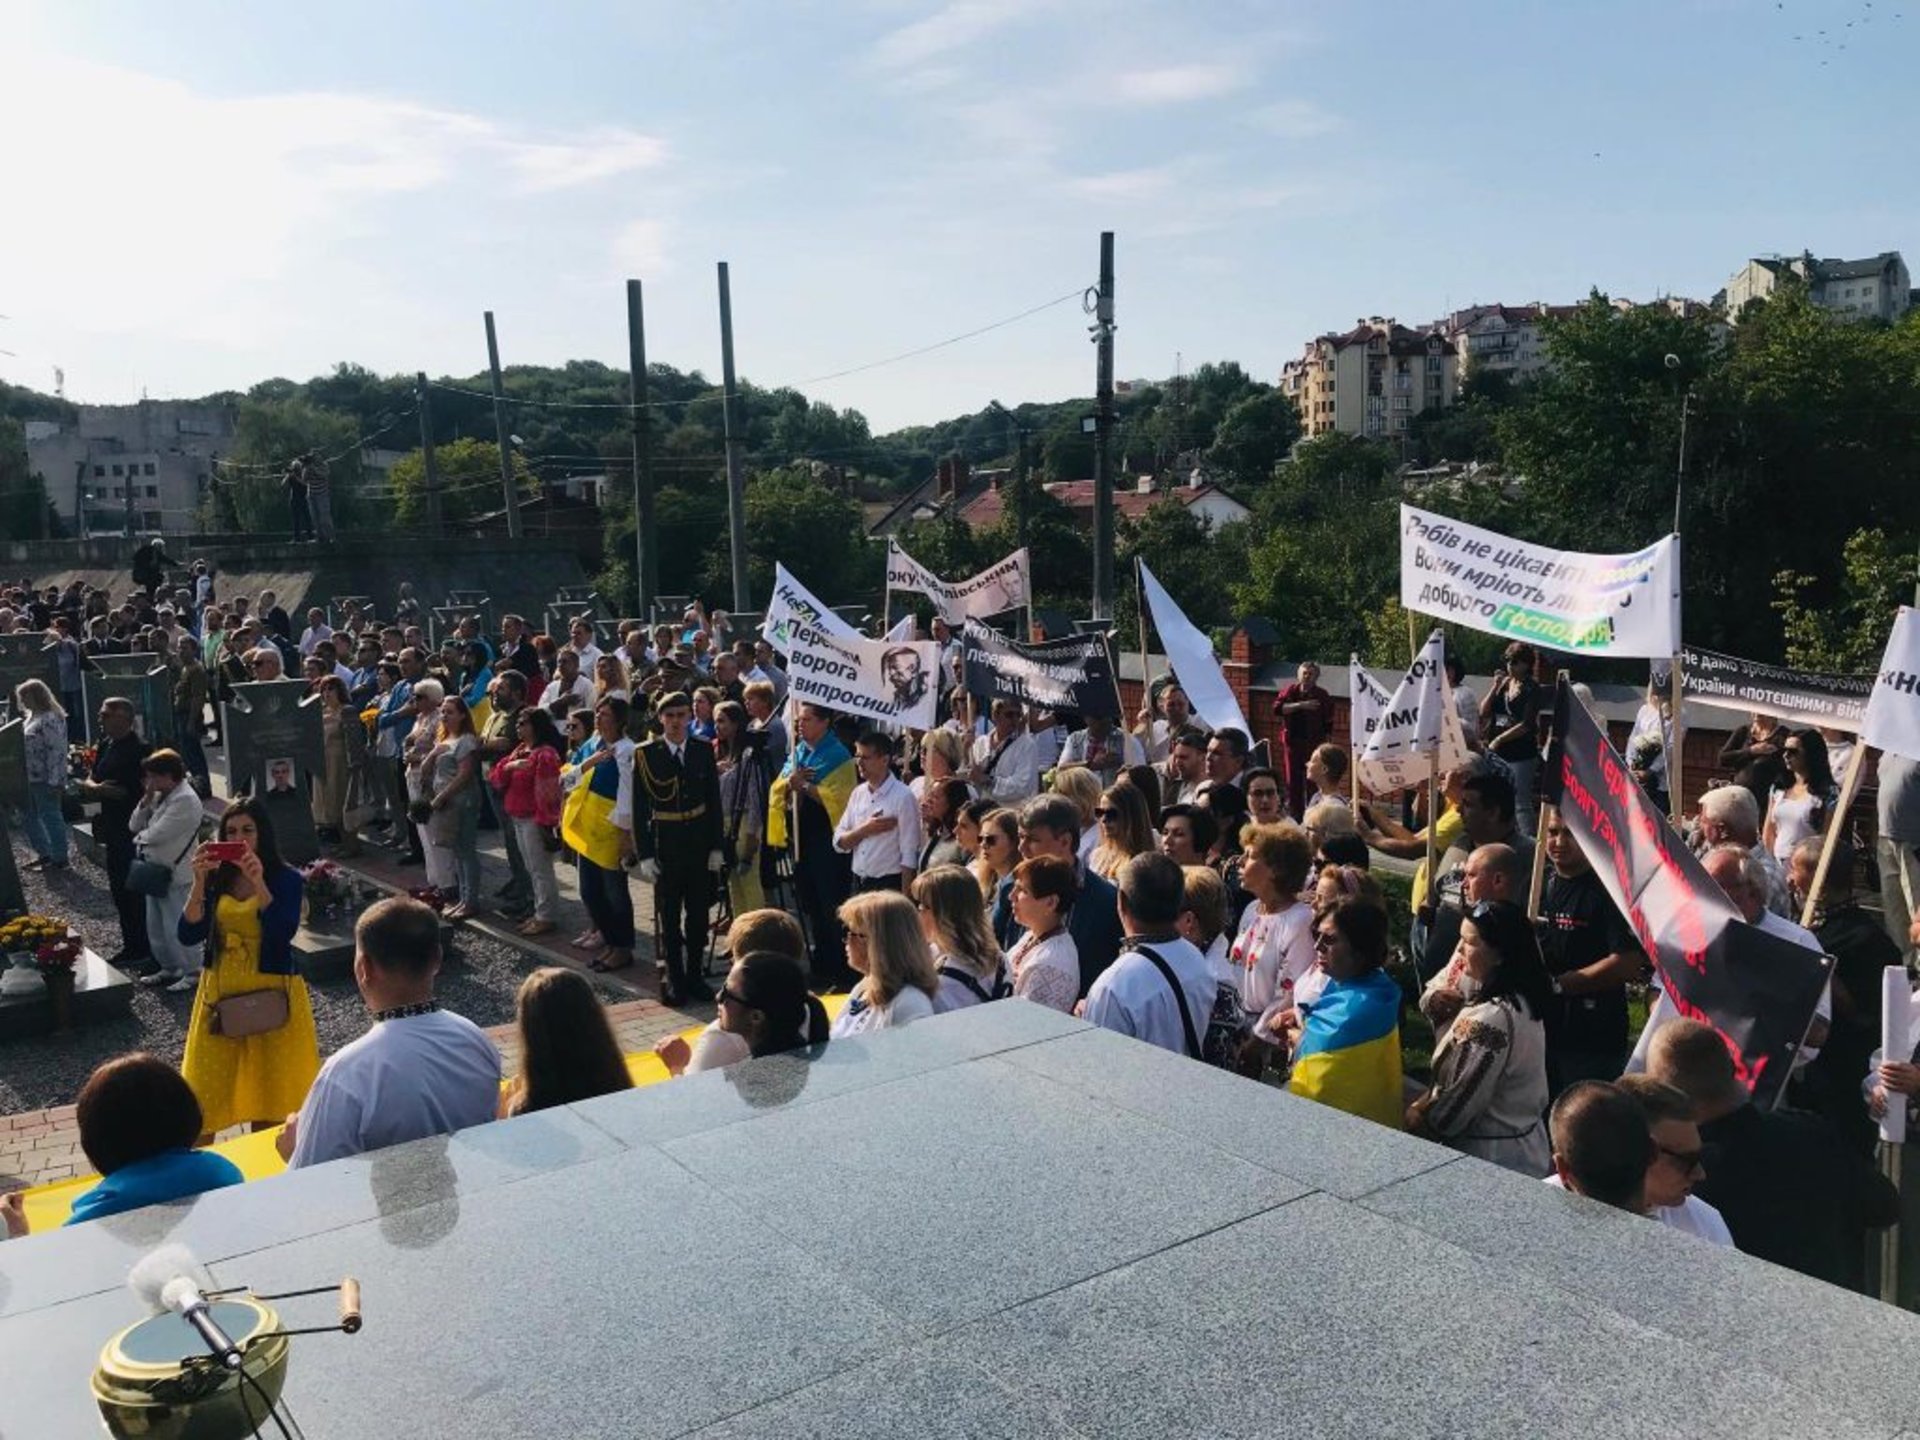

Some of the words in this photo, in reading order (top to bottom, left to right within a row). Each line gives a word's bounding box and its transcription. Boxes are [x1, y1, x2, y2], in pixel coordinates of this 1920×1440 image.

[1405, 514, 1461, 548] Рабів
[1461, 539, 1491, 558] не
[1418, 582, 1497, 617] доброго
[1461, 567, 1546, 604] мріють
[791, 651, 858, 681] ворога
[1700, 655, 1739, 673] дамо
[794, 677, 901, 717] випросиш!
[1681, 671, 1736, 697] України
